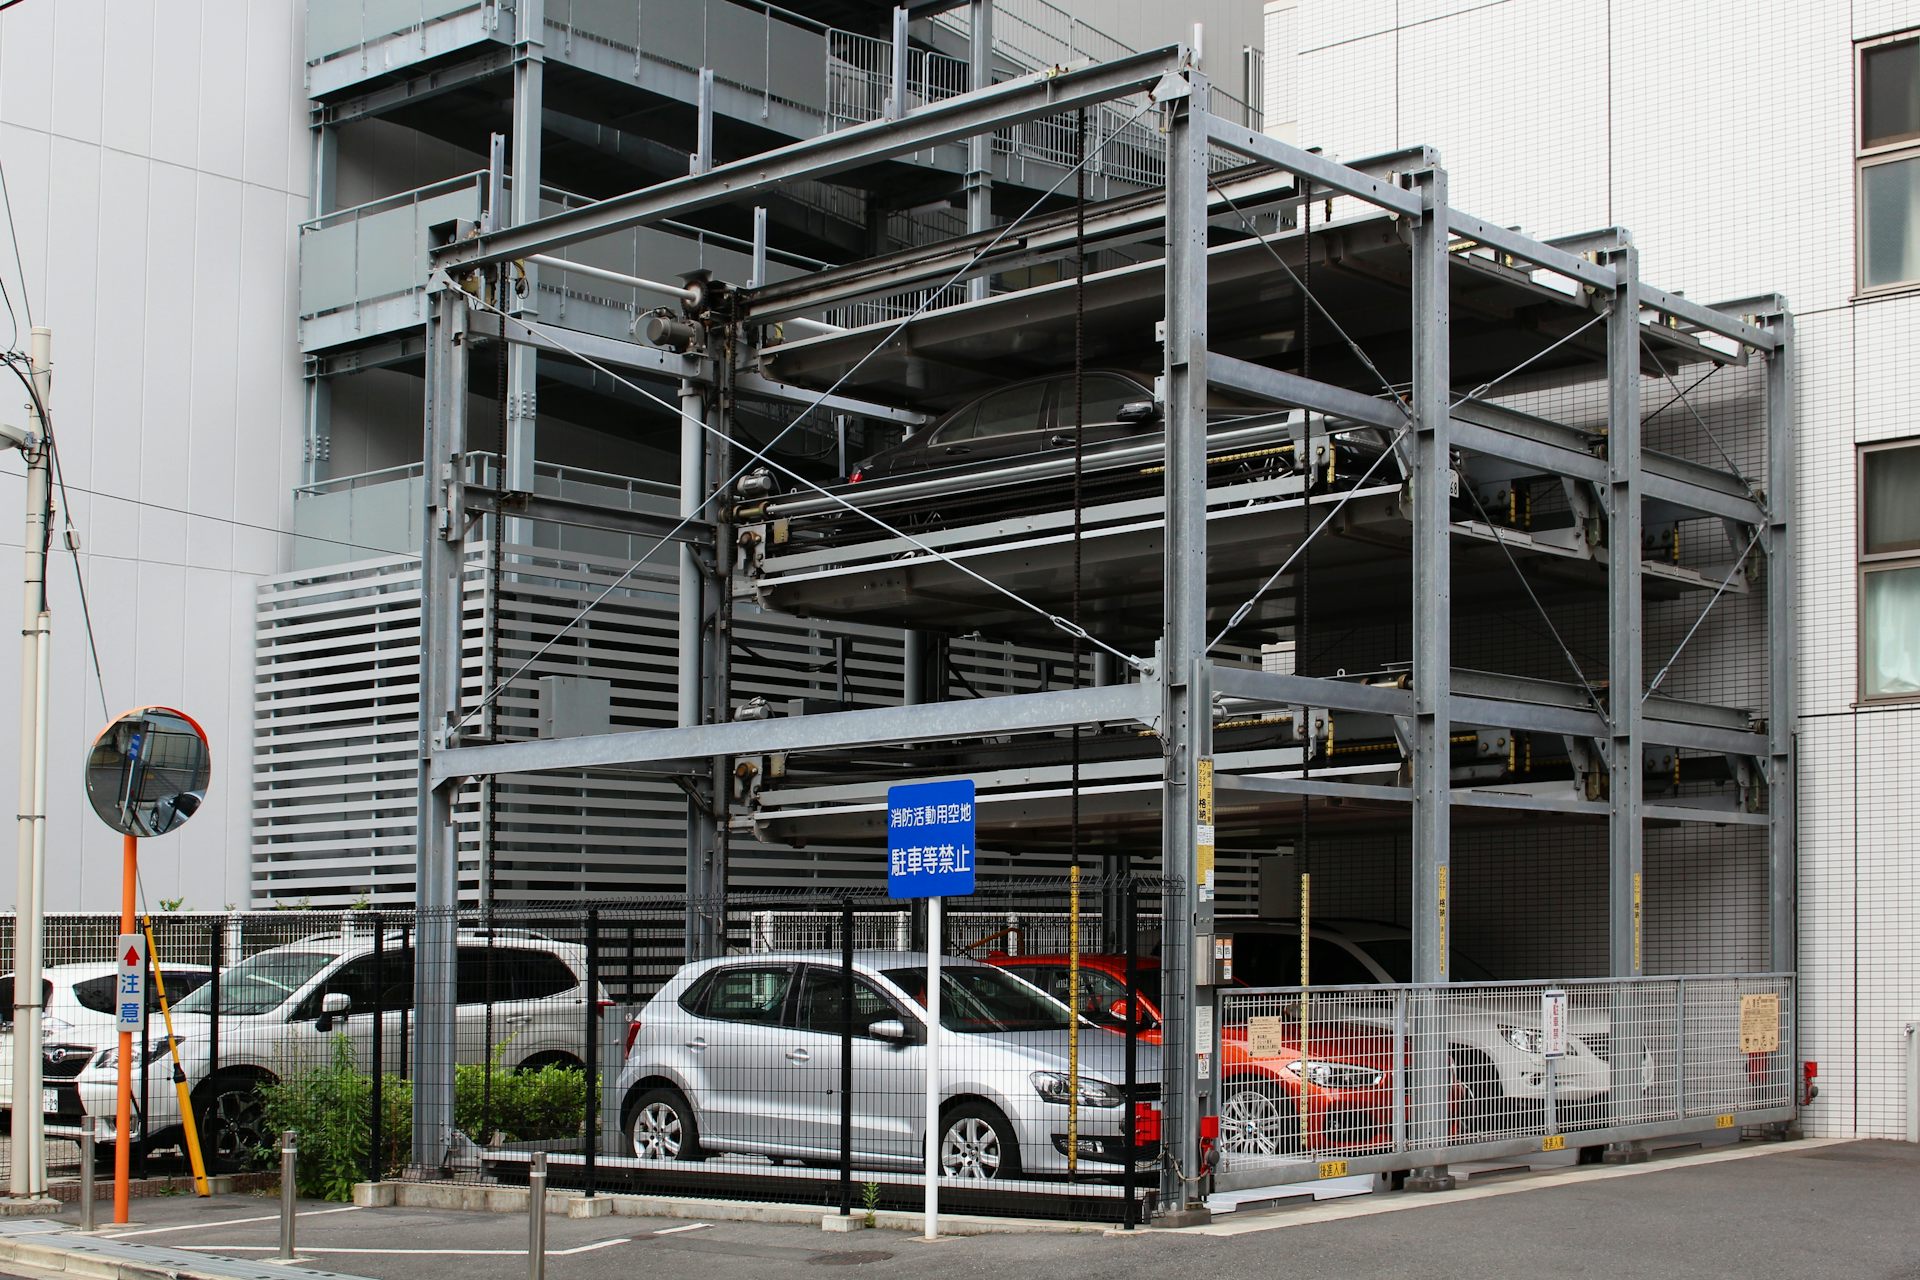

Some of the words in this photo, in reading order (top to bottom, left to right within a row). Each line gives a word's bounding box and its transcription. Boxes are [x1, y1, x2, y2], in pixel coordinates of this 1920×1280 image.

[890, 803, 972, 828] 消防活動用空地
[1199, 798, 1206, 819] 格納
[891, 844, 971, 876] 駐車等禁止
[120, 974, 140, 1023] 注意
